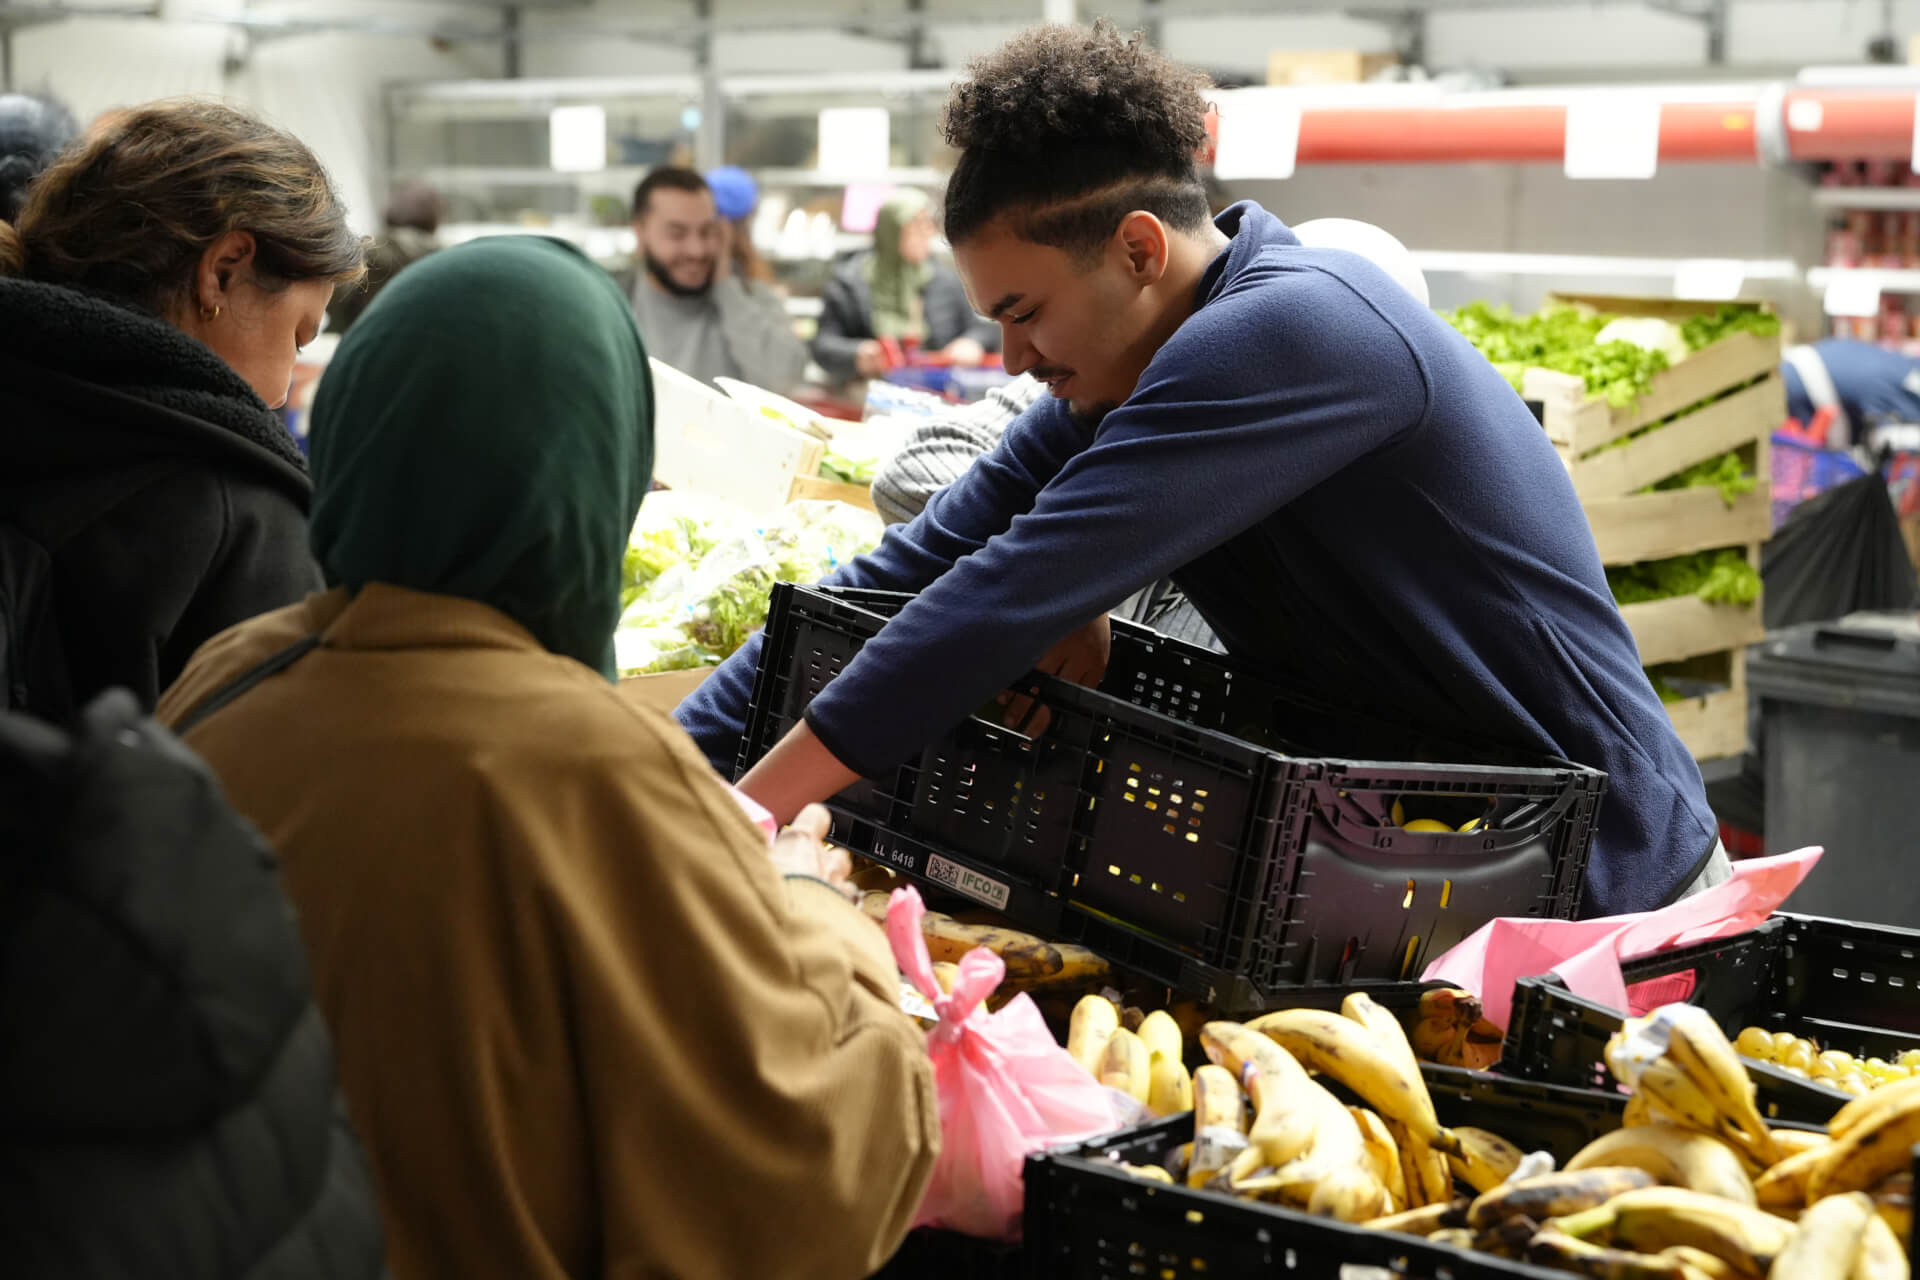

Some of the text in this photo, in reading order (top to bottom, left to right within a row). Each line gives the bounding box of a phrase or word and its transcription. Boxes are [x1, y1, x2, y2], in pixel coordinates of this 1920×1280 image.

[874, 842, 914, 868] LL 6418
[962, 871, 992, 893] IFCO
